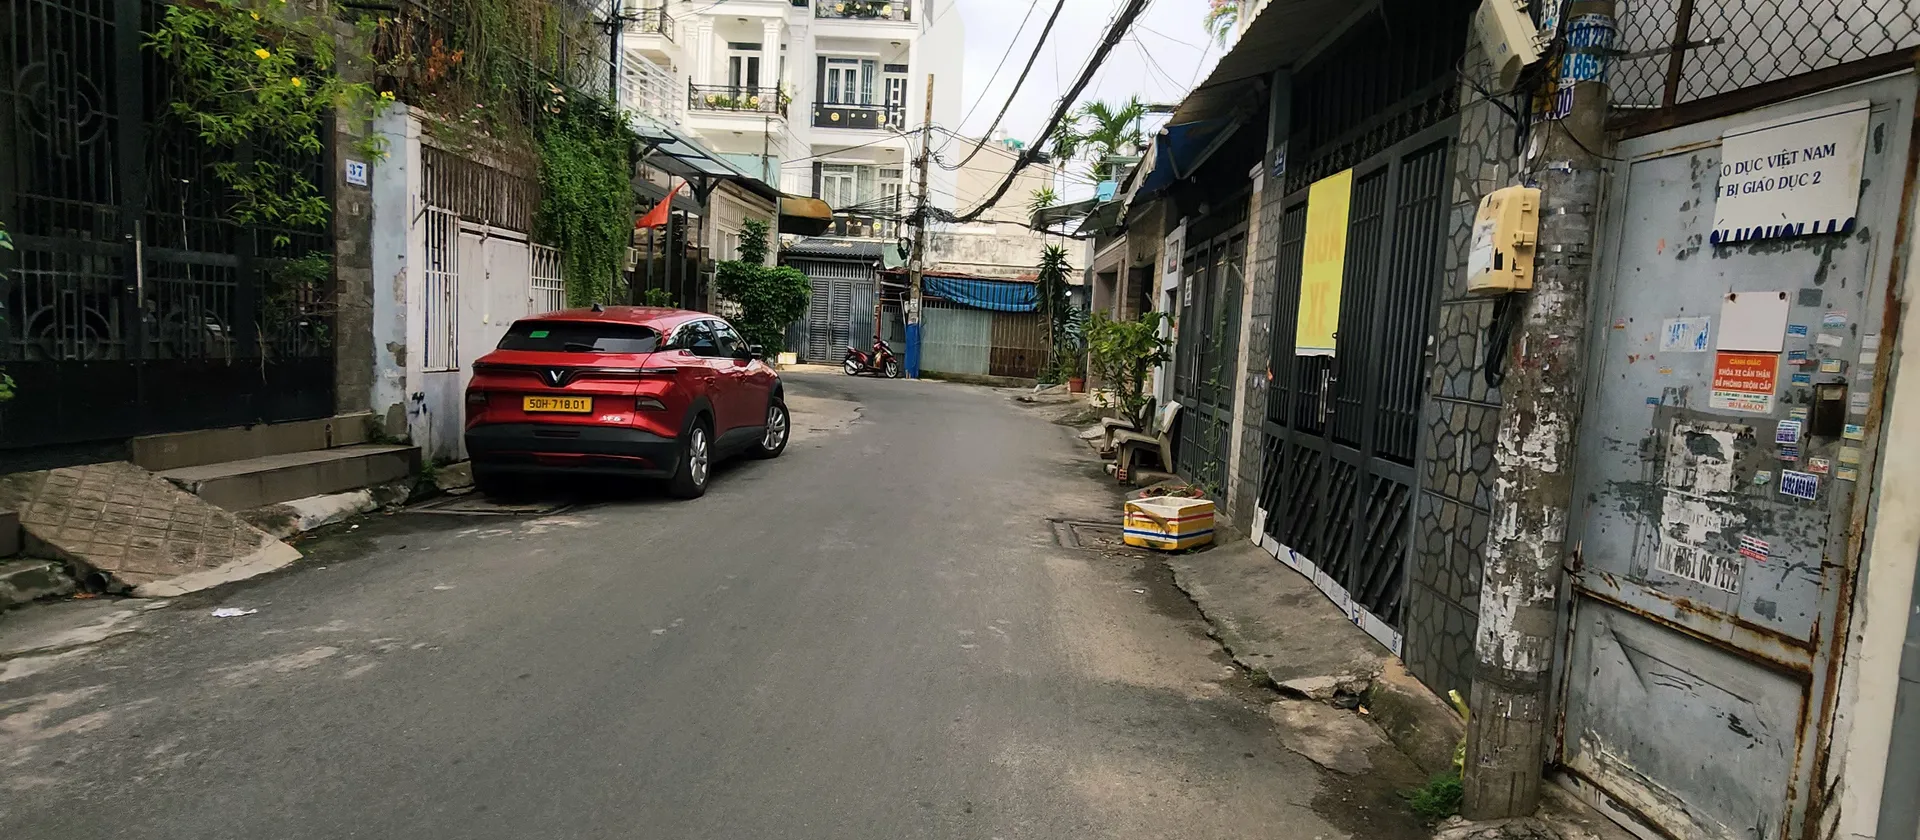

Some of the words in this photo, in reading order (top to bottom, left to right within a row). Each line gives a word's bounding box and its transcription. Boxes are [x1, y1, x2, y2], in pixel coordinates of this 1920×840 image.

[349, 163, 363, 177] 37
[1735, 158, 1763, 176] DỤC
[1767, 149, 1799, 169] VIỆT
[1802, 142, 1836, 162] NAM
[1726, 183, 1739, 198] BỊ
[1743, 176, 1774, 195] GIÁO
[1777, 173, 1809, 192] DỤC
[1812, 171, 1821, 185] 2
[1700, 554, 1712, 584] 06
